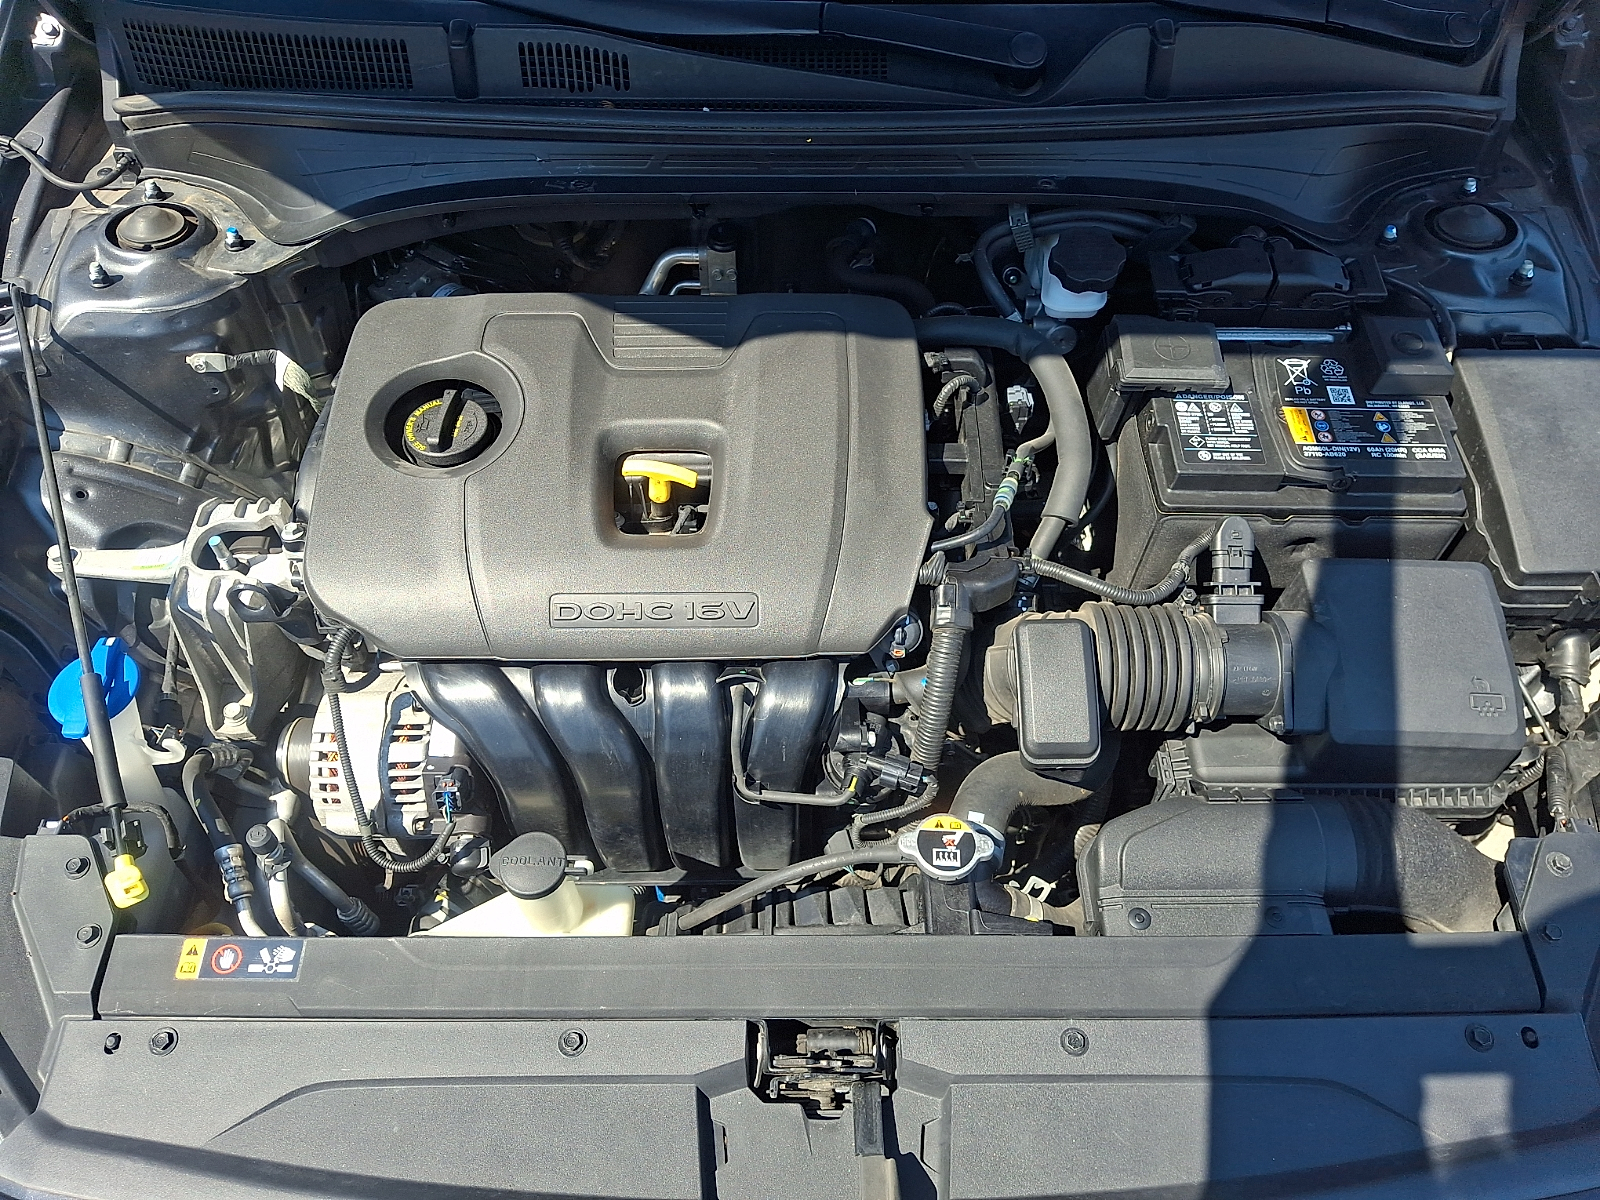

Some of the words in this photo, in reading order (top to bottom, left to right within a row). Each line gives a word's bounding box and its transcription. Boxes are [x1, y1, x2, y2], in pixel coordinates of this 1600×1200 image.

[1295, 386, 1312, 395] Pb
[414, 399, 442, 416] MANUAL
[413, 441, 426, 451] SEE
[553, 601, 674, 621] DOHC
[685, 601, 756, 621] 16V
[502, 856, 565, 867] COOLANT
